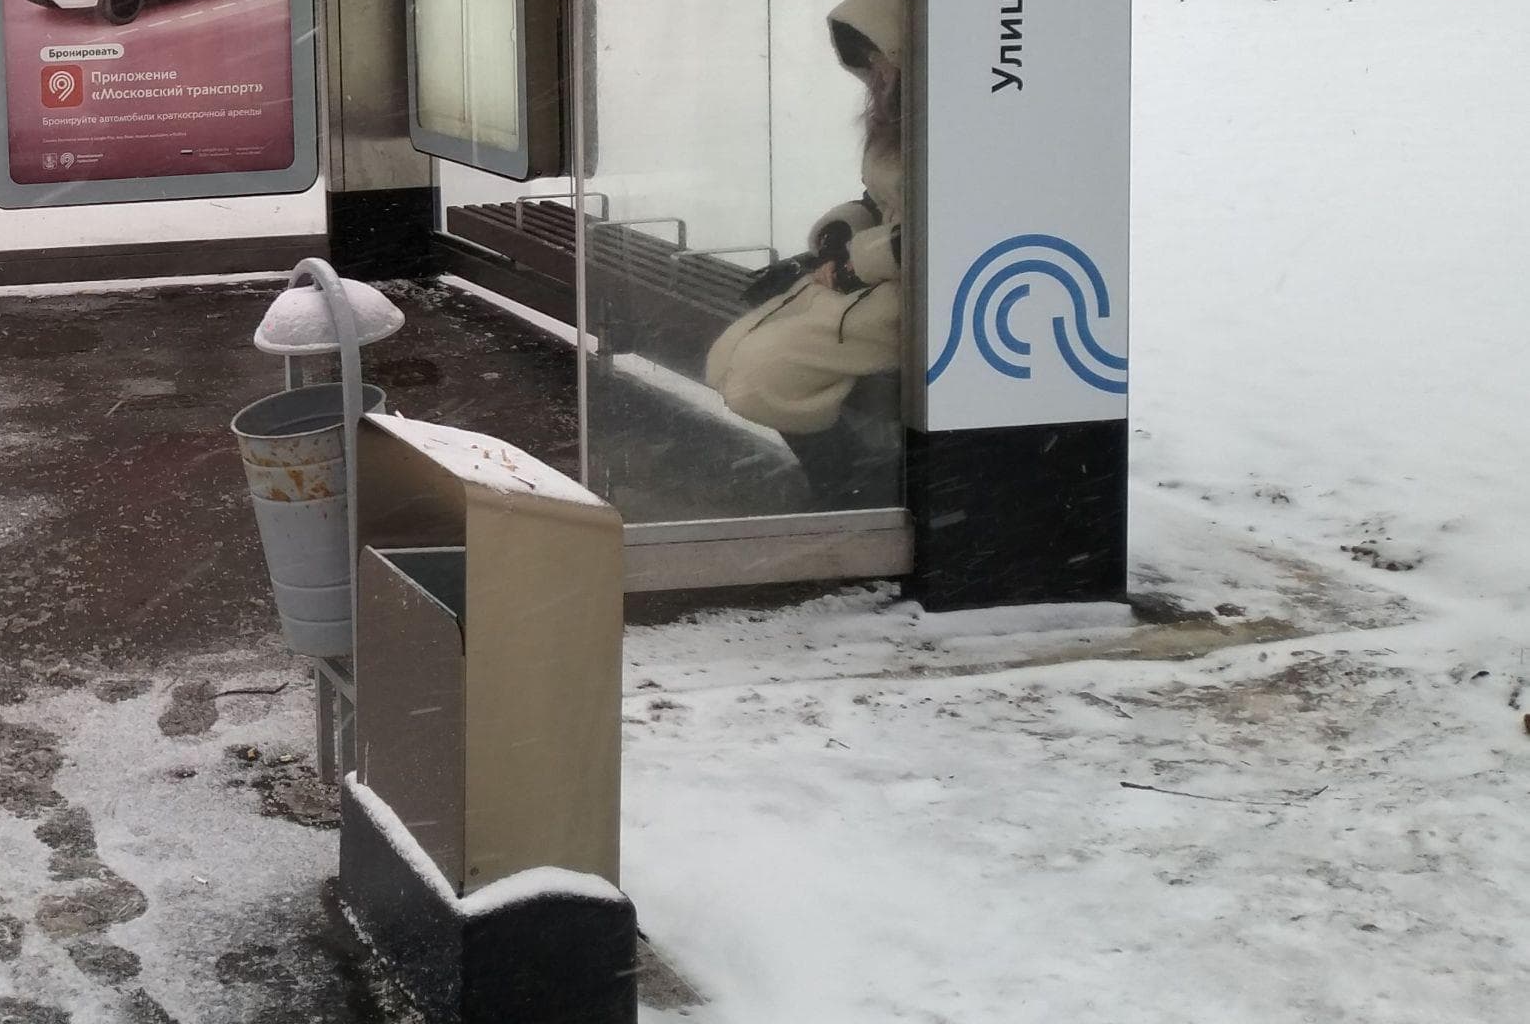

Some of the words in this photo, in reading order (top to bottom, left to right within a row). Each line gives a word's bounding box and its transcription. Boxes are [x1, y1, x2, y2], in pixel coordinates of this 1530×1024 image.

[48, 47, 119, 60] Бронировать
[90, 69, 177, 86] Приложение
[91, 84, 183, 101] «Московский
[186, 82, 263, 100] транспорт»
[42, 115, 98, 128] Бронируйте
[99, 112, 156, 124] автомобили
[156, 108, 226, 121] краткосрочной
[227, 106, 263, 118] аренды
